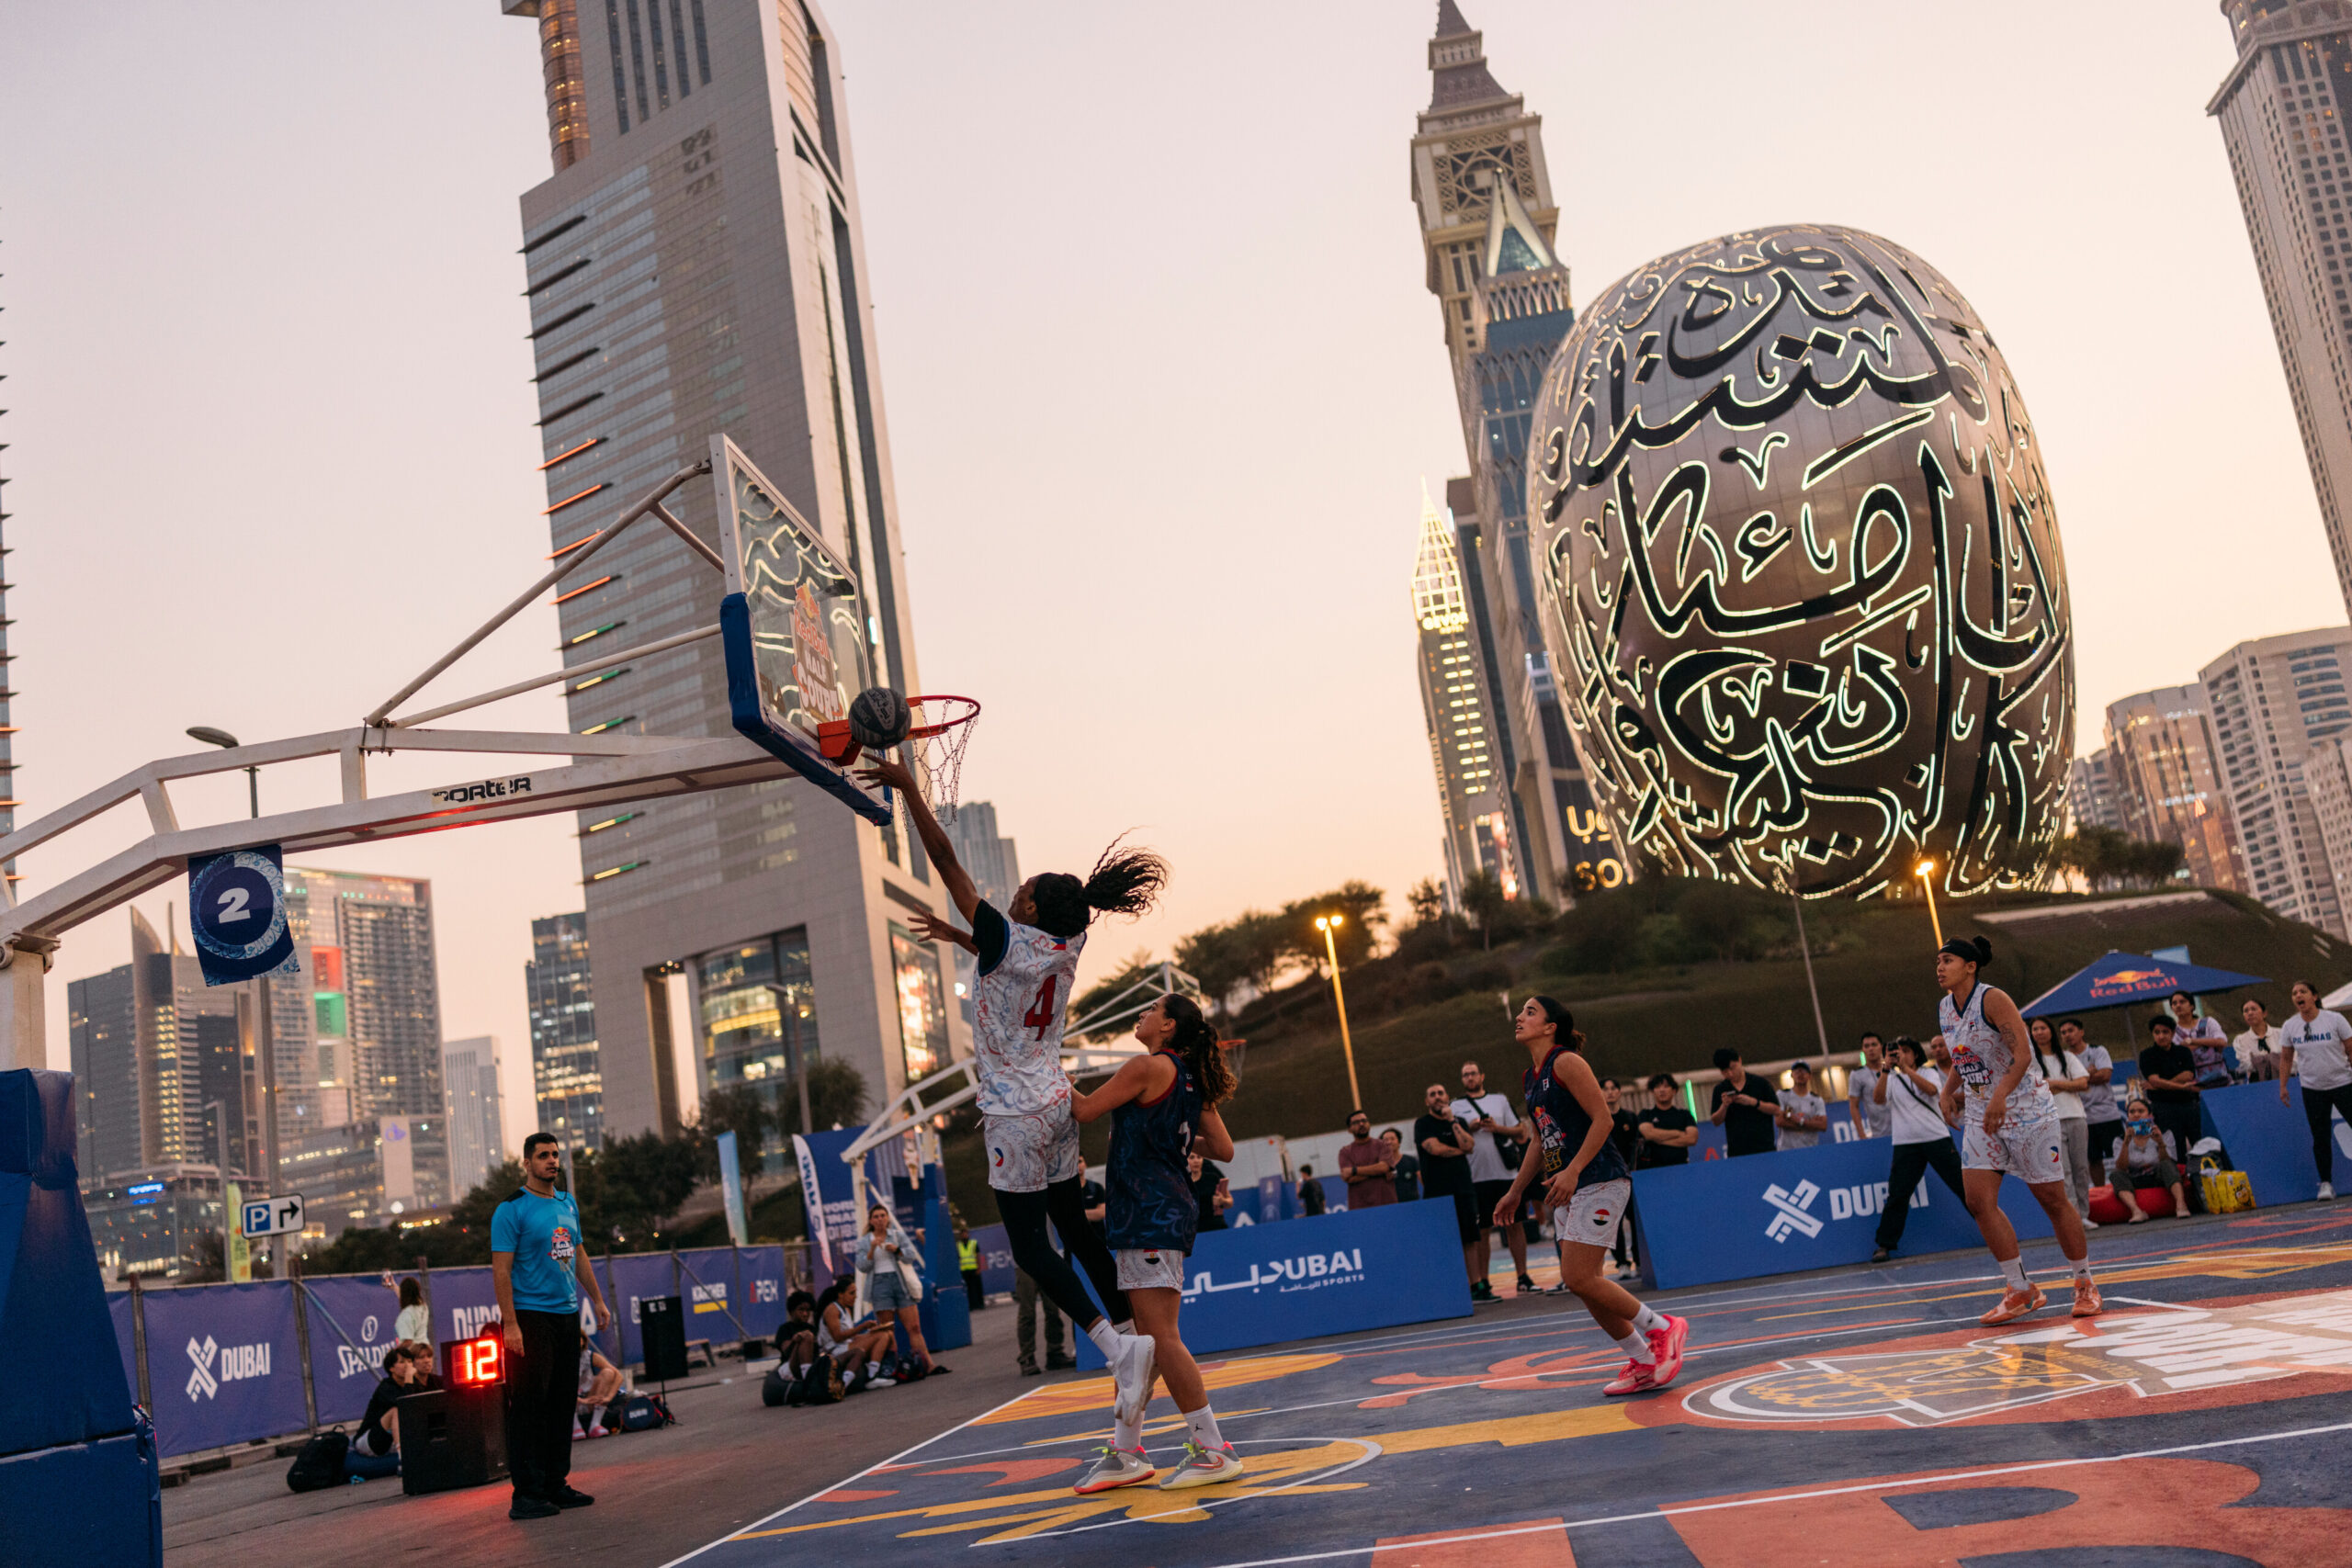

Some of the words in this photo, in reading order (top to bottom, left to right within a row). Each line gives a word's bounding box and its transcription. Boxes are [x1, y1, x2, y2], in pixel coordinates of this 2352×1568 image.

[804, 649, 826, 684] HALF
[217, 887, 251, 924] 2
[2090, 982, 2132, 998] Red
[2135, 976, 2177, 992] Bull
[1023, 974, 1057, 1042] 4
[1961, 1068, 1991, 1085] OURT
[250, 1207, 269, 1232] P
[1322, 1273, 1365, 1287] SPORTS
[221, 1342, 271, 1382] DUBAI
[464, 1339, 499, 1381] 12
